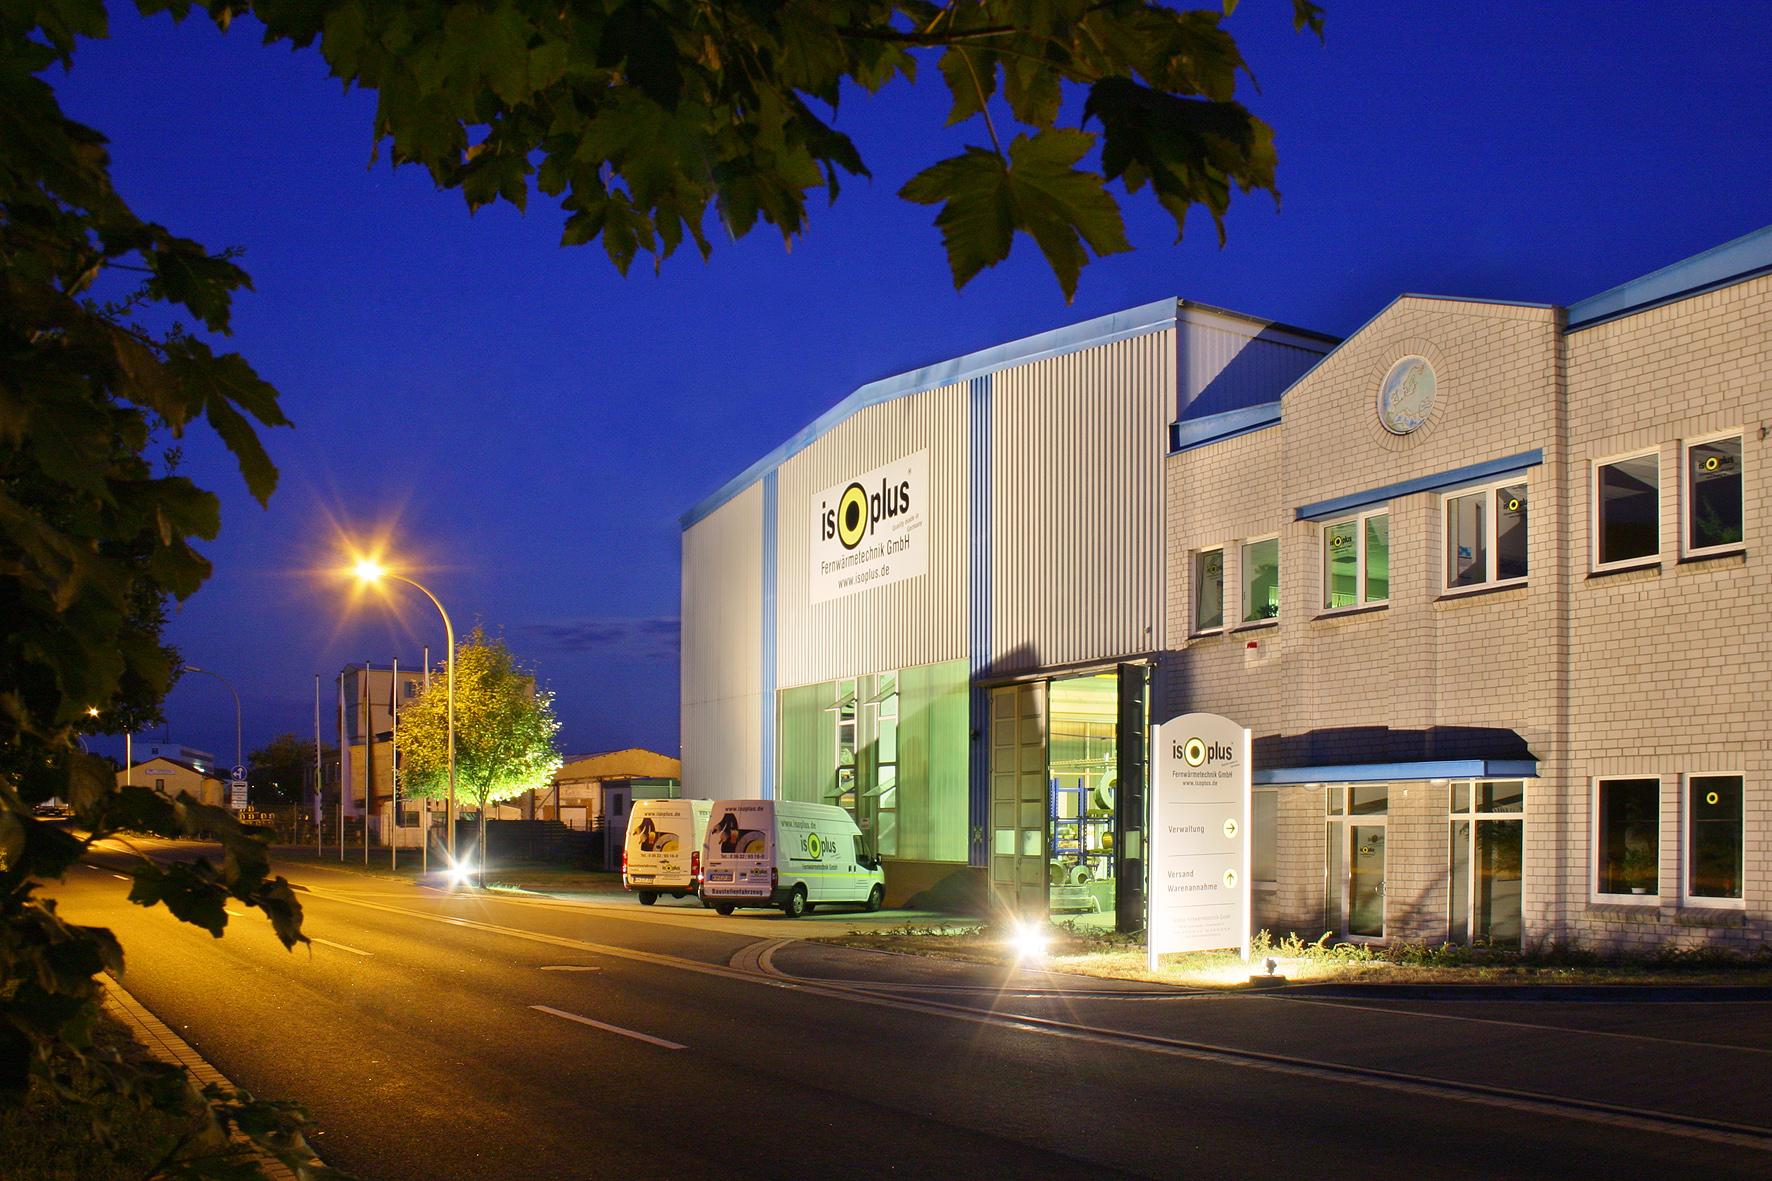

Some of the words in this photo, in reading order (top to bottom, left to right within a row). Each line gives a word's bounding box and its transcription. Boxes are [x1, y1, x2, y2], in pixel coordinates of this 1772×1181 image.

[821, 543, 885, 576] Fernwärmetechnik
[886, 533, 910, 555] GmbH
[837, 564, 890, 589] www.isoplus.de
[1218, 770, 1233, 778] GmbH
[1168, 825, 1205, 834] Verwaltung
[1168, 870, 1194, 878] Versand
[1167, 884, 1218, 892] Warenannahme
